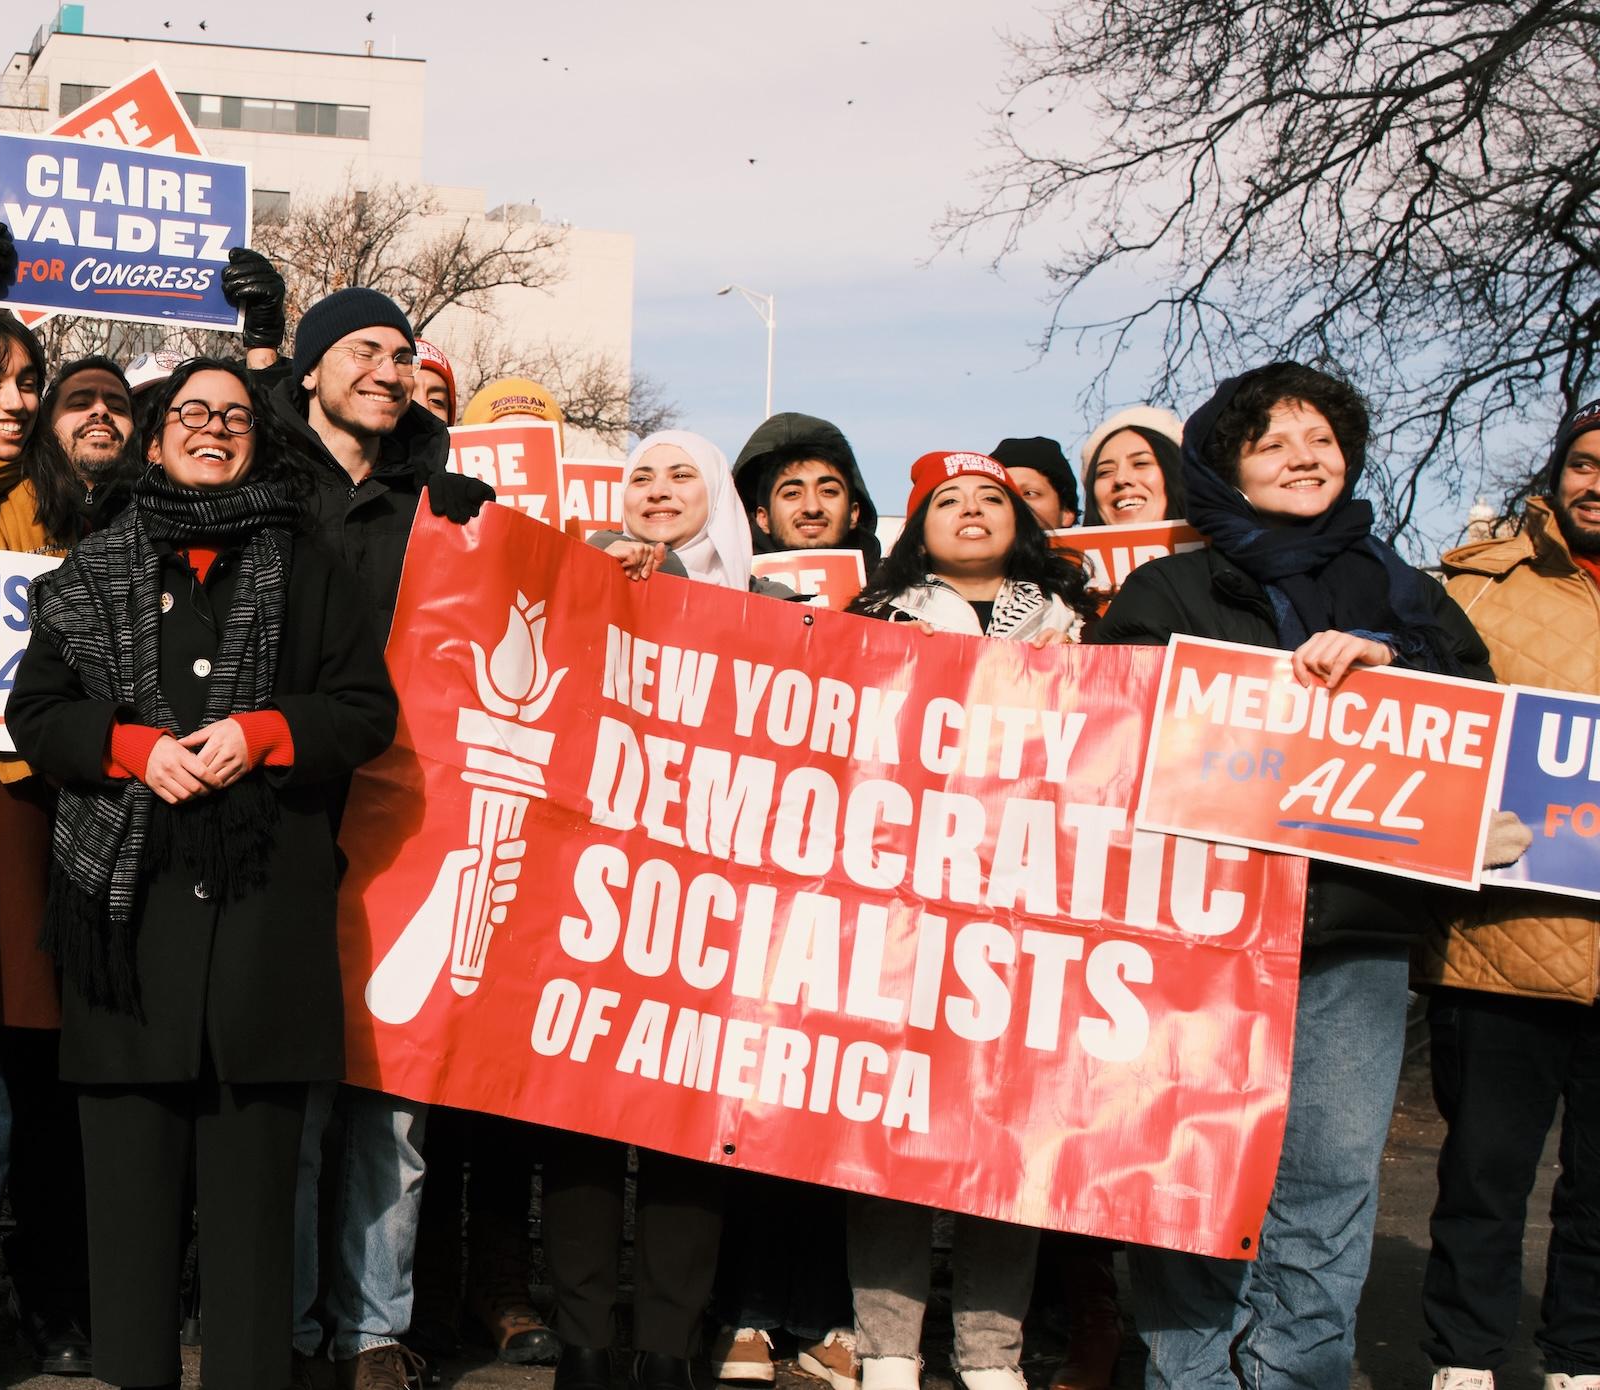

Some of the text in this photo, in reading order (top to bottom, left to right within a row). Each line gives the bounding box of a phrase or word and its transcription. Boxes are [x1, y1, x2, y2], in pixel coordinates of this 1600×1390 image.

[4, 203, 232, 262] VALDEZ
[26, 154, 212, 216] CLAIRE
[16, 258, 214, 292] FOR CONGRESS
[603, 623, 1087, 783] NEW YORK CITY
[1173, 666, 1491, 769] MEDICARE
[587, 715, 1249, 936] DEMOCRATIC
[1200, 747, 1426, 830] FOR ALL
[559, 843, 1154, 1062] SOCIALISTS
[530, 978, 931, 1134] OF AMERICA
